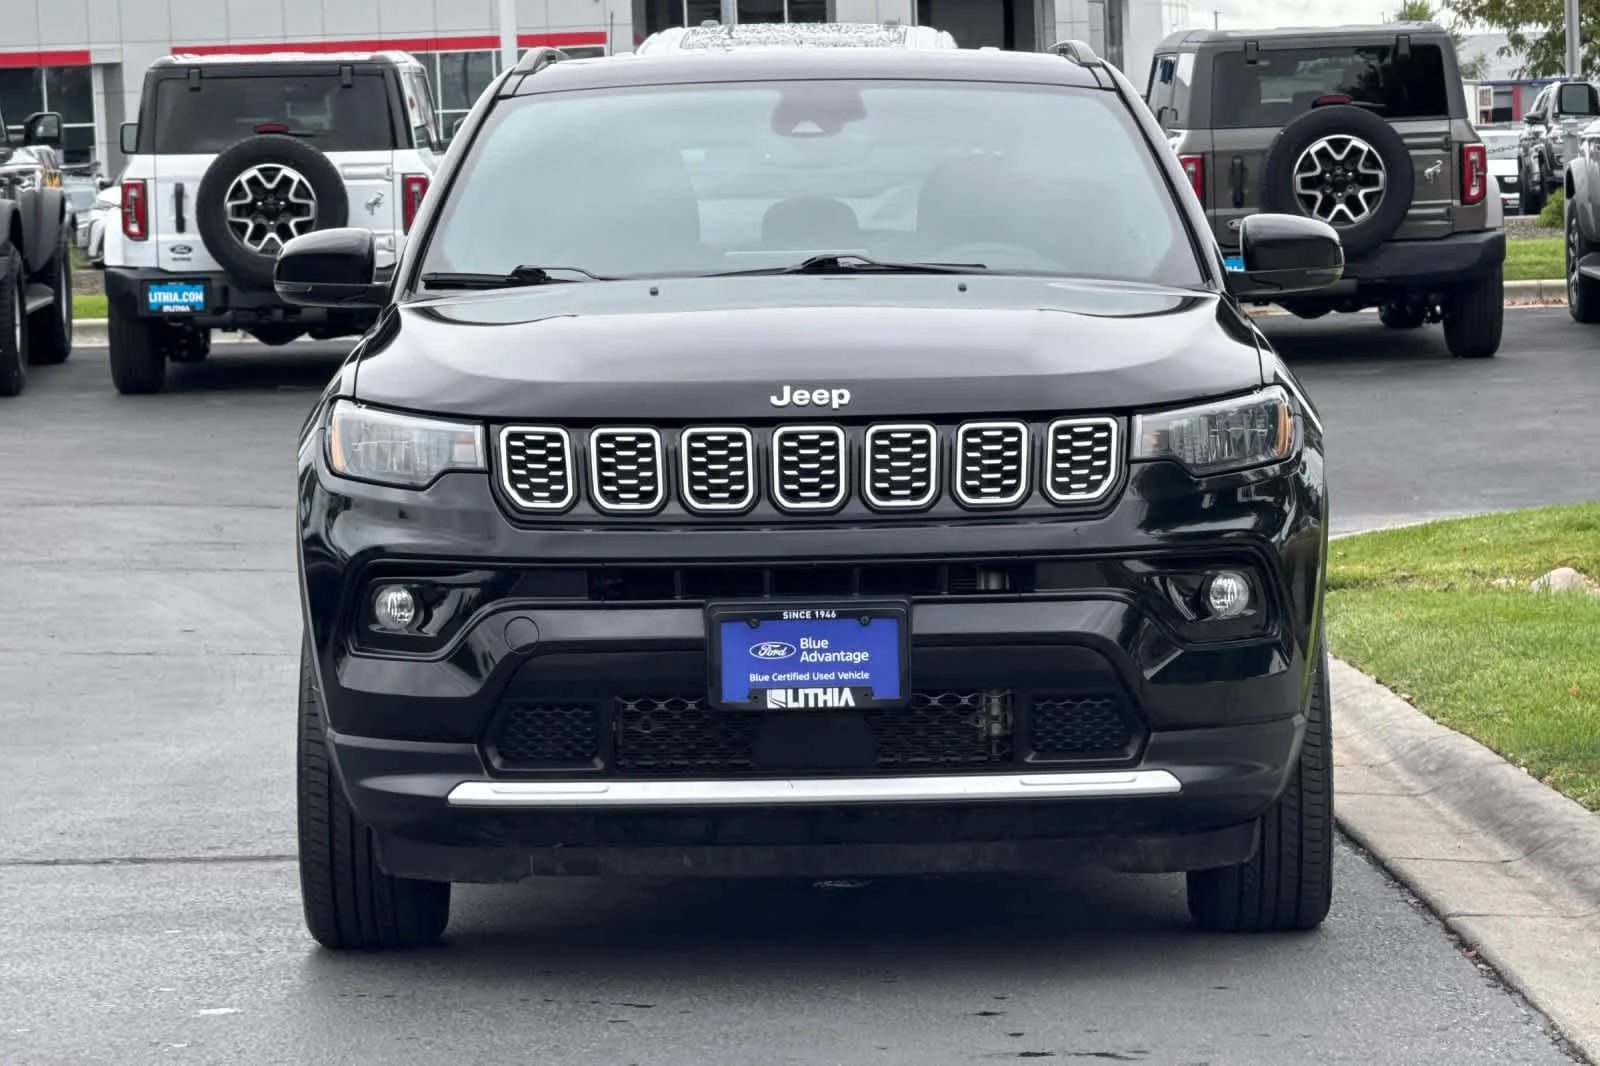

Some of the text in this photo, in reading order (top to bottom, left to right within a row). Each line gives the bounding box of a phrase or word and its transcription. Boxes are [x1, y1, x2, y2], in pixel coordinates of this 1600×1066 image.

[148, 291, 204, 303] LITHIA.COM
[769, 385, 851, 409] Jeep
[782, 610, 837, 620] SINCE 1946
[800, 637, 829, 650] Blue
[758, 644, 787, 657] Ford
[800, 650, 870, 664] Advantage
[749, 671, 870, 682] Blue Certified Used Vehicle
[787, 687, 855, 708] LITHIA
